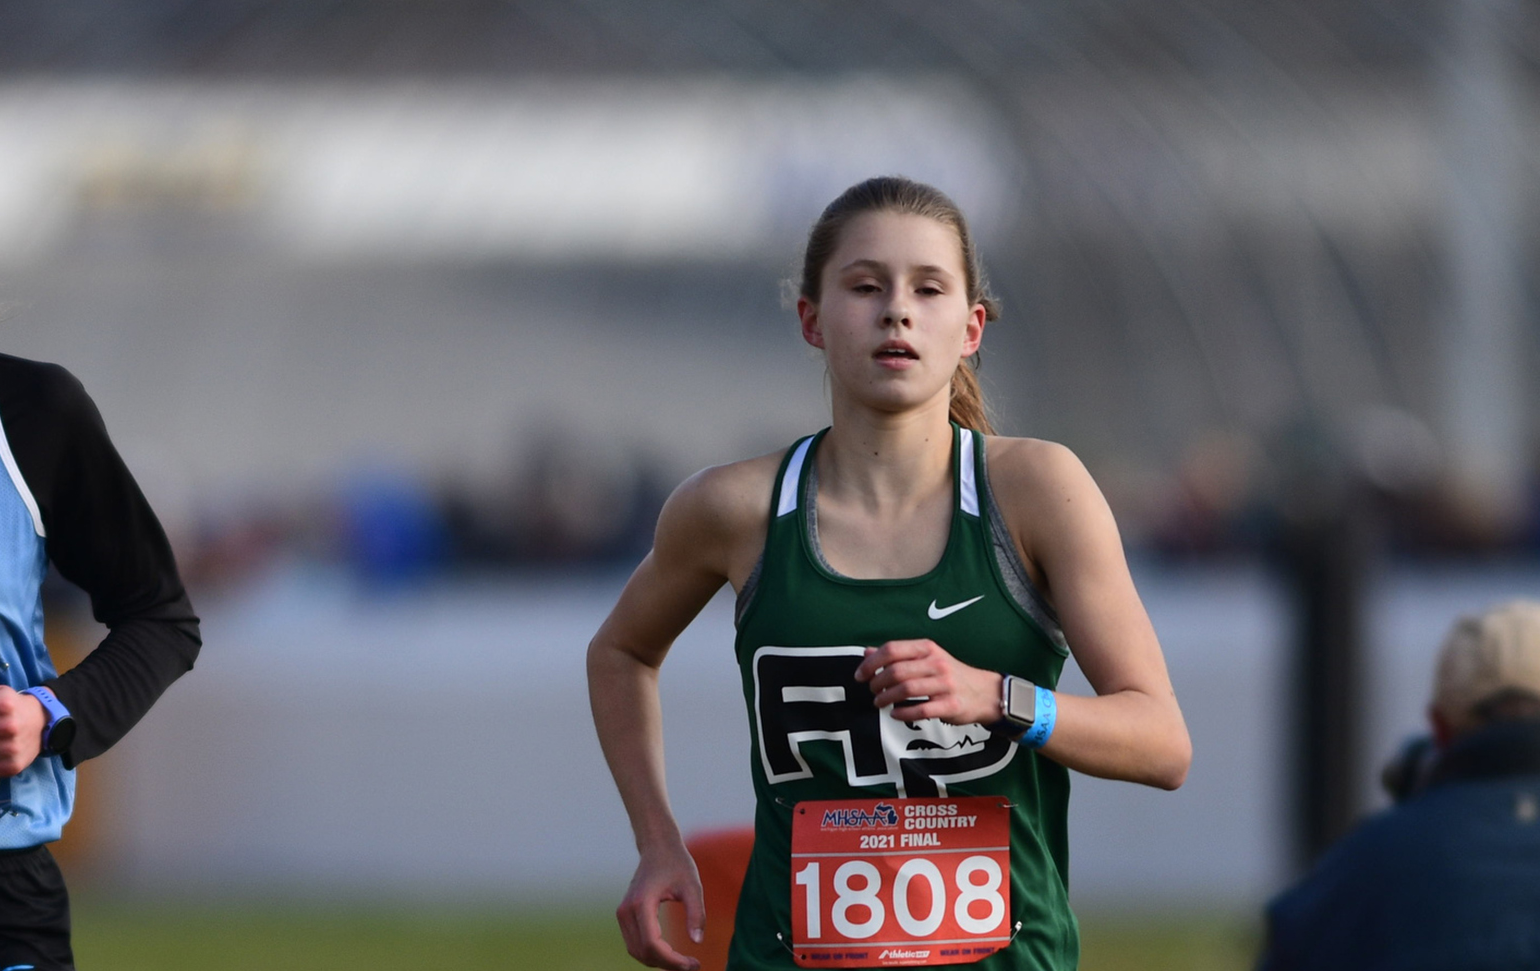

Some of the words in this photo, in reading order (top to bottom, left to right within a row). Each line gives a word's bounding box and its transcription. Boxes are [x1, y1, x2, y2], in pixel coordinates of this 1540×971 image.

[904, 804, 958, 817] CROSS
[904, 815, 978, 830] COUNTRY
[860, 834, 895, 849] 2021
[900, 832, 941, 848] FINAL
[795, 855, 1006, 940] 1808
